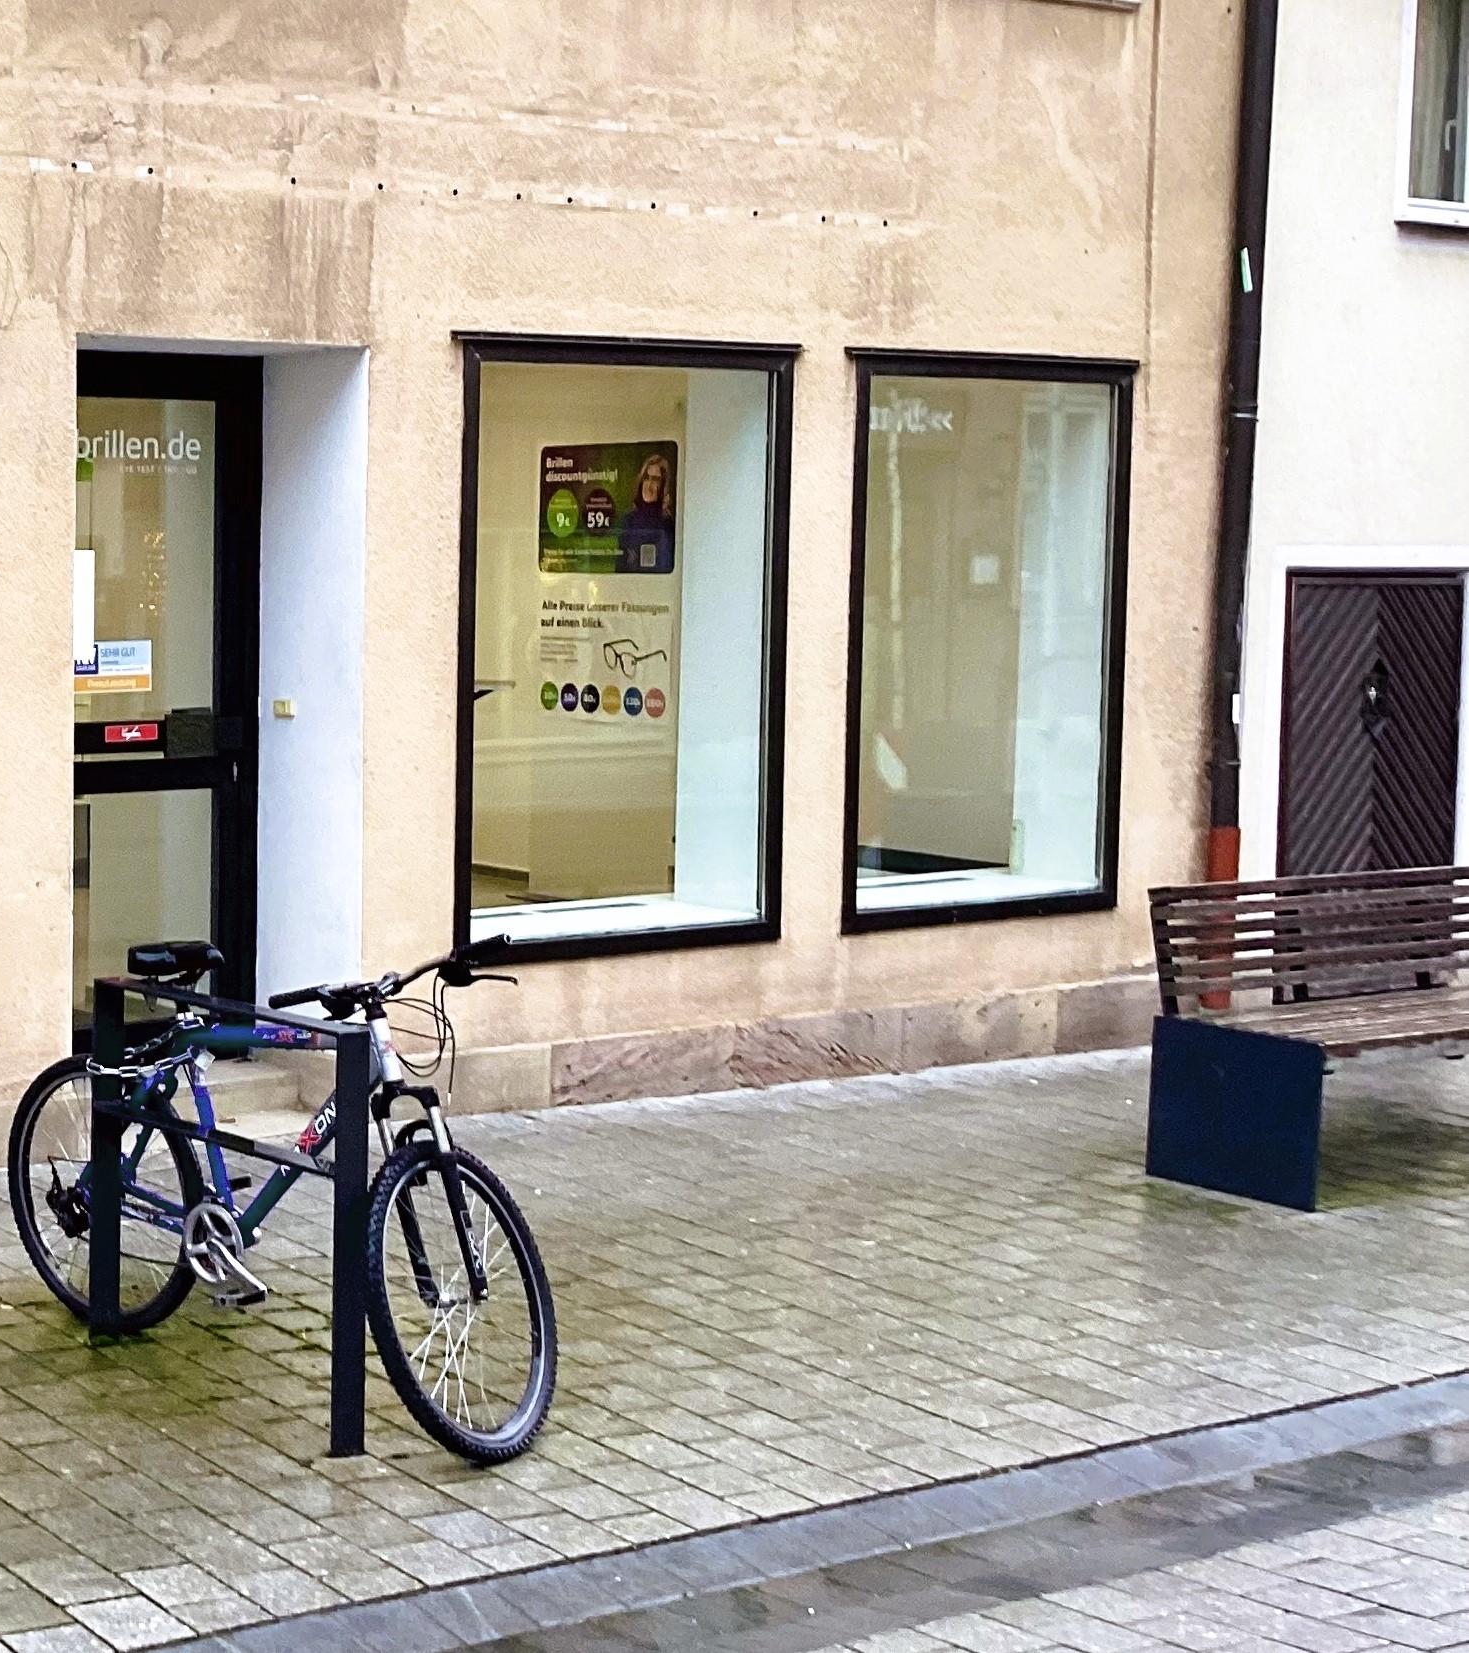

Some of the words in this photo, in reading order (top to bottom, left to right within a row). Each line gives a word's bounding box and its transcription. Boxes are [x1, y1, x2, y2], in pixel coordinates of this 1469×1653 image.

[77, 429, 201, 460] brillen.de
[546, 456, 574, 468] Brillen
[542, 600, 558, 611] Alle
[540, 617, 555, 627] auf
[557, 617, 580, 628] einen
[121, 646, 136, 657] GUT
